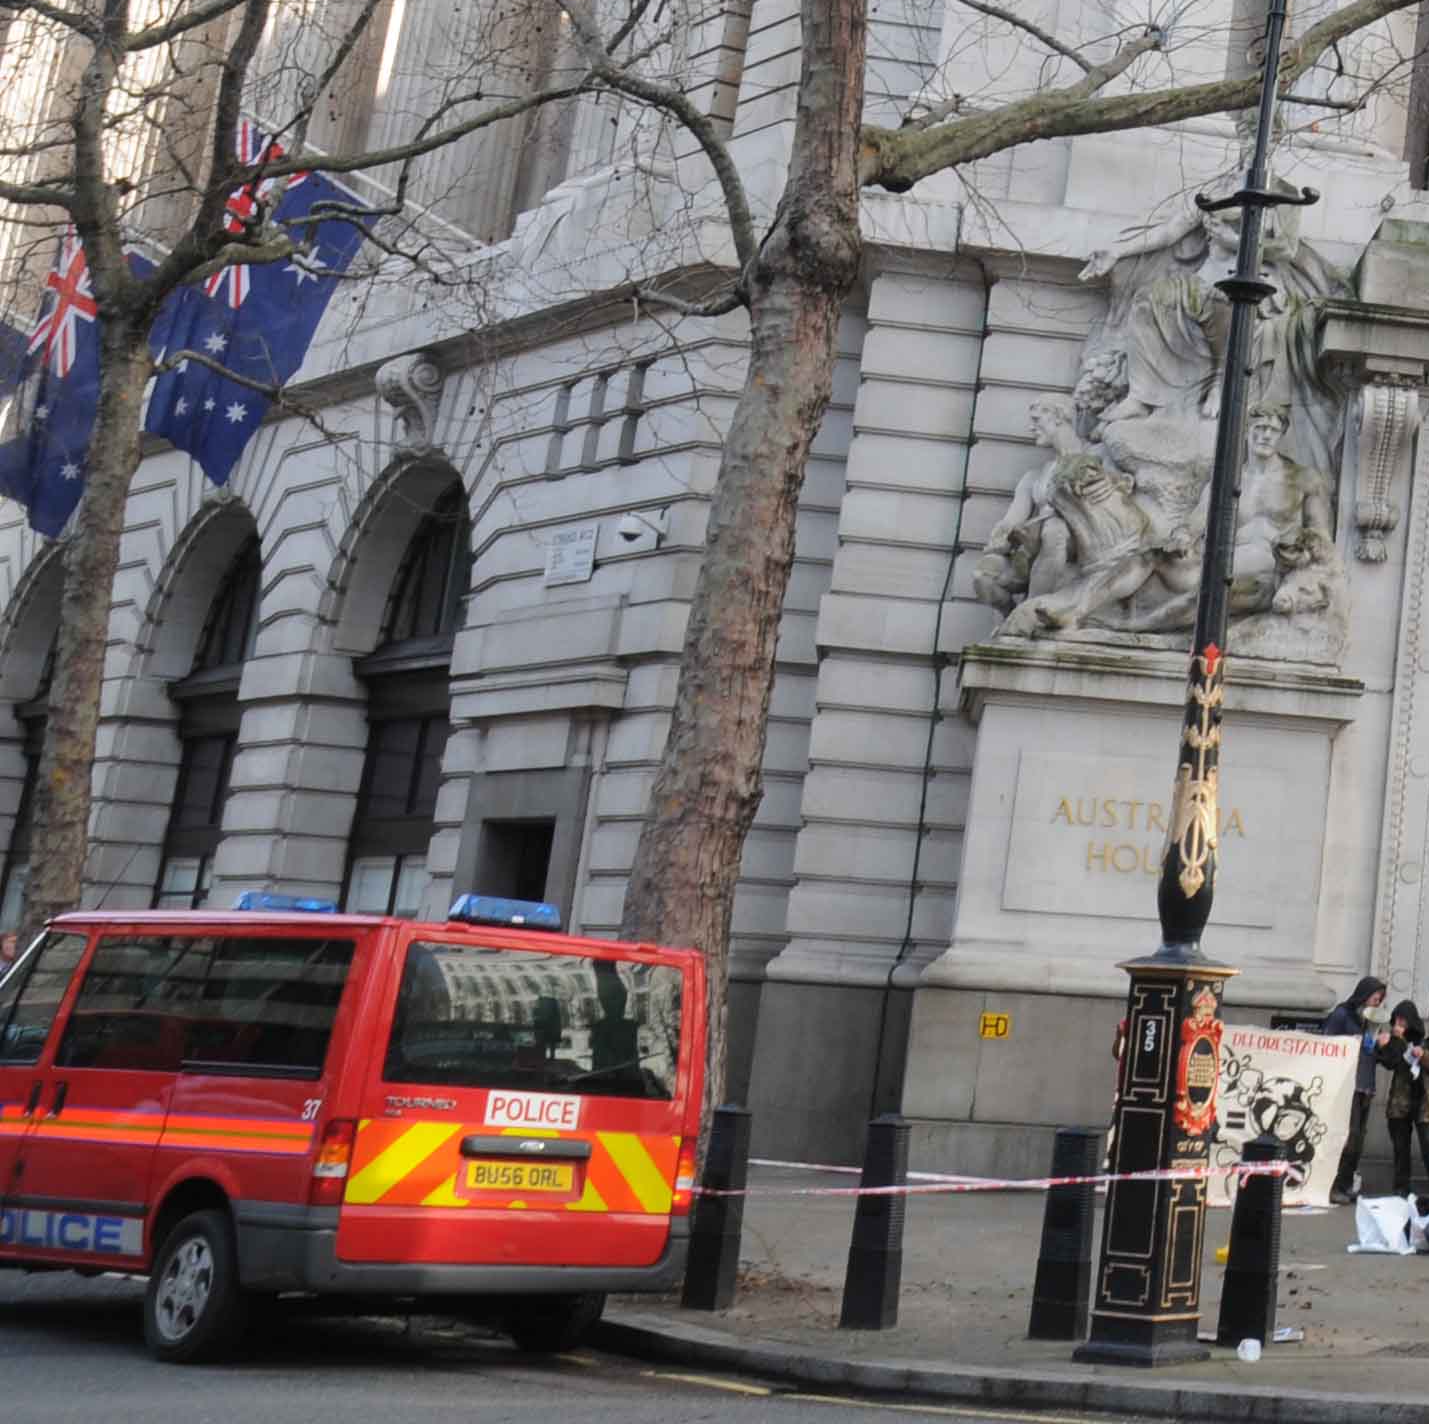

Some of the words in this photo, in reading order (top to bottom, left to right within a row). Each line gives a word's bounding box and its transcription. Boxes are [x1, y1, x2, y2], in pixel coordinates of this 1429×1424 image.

[1050, 799, 1246, 838] AUSTRIA
[301, 1099, 322, 1120] 37
[490, 1096, 576, 1125] POLICE
[474, 1165, 524, 1185] BU56
[0, 1209, 124, 1253] OLICE
